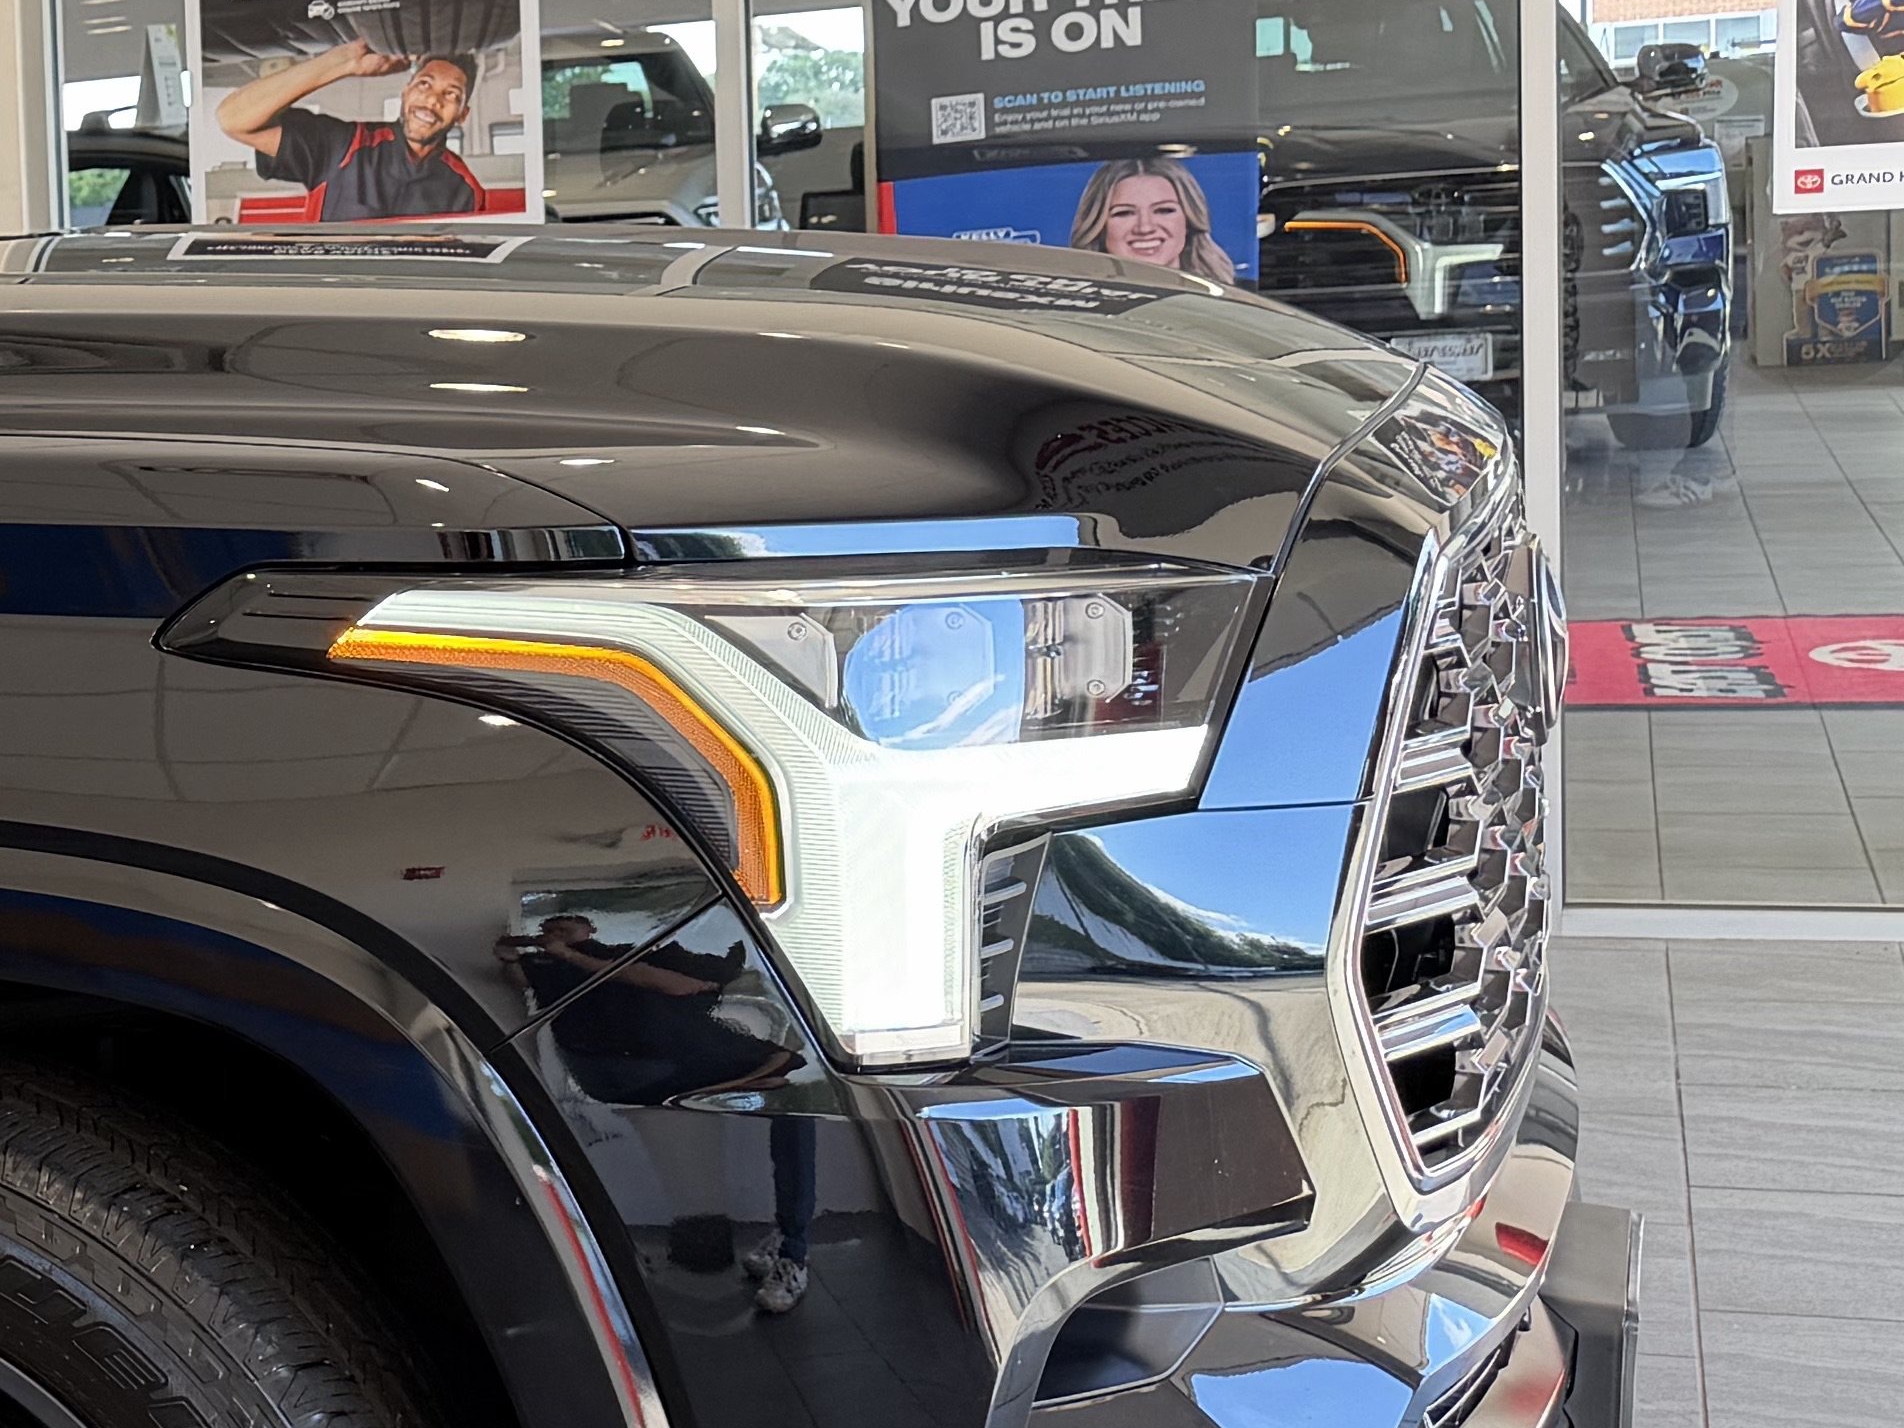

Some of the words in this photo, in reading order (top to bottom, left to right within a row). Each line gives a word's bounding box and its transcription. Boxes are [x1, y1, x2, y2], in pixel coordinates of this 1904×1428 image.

[980, 16, 1037, 61] IS
[1050, 6, 1142, 53] ON
[993, 93, 1038, 109] SCAN
[1042, 91, 1064, 105] TO
[1065, 85, 1118, 102] START
[1120, 79, 1206, 97] LISTENING
[994, 121, 1032, 134] vehicle
[1033, 120, 1054, 130] and
[1071, 117, 1089, 127] the
[1090, 112, 1138, 125] SiriusXM
[1024, 109, 1049, 121] your
[1085, 105, 1109, 117] your
[1831, 171, 1895, 186] GRAND
